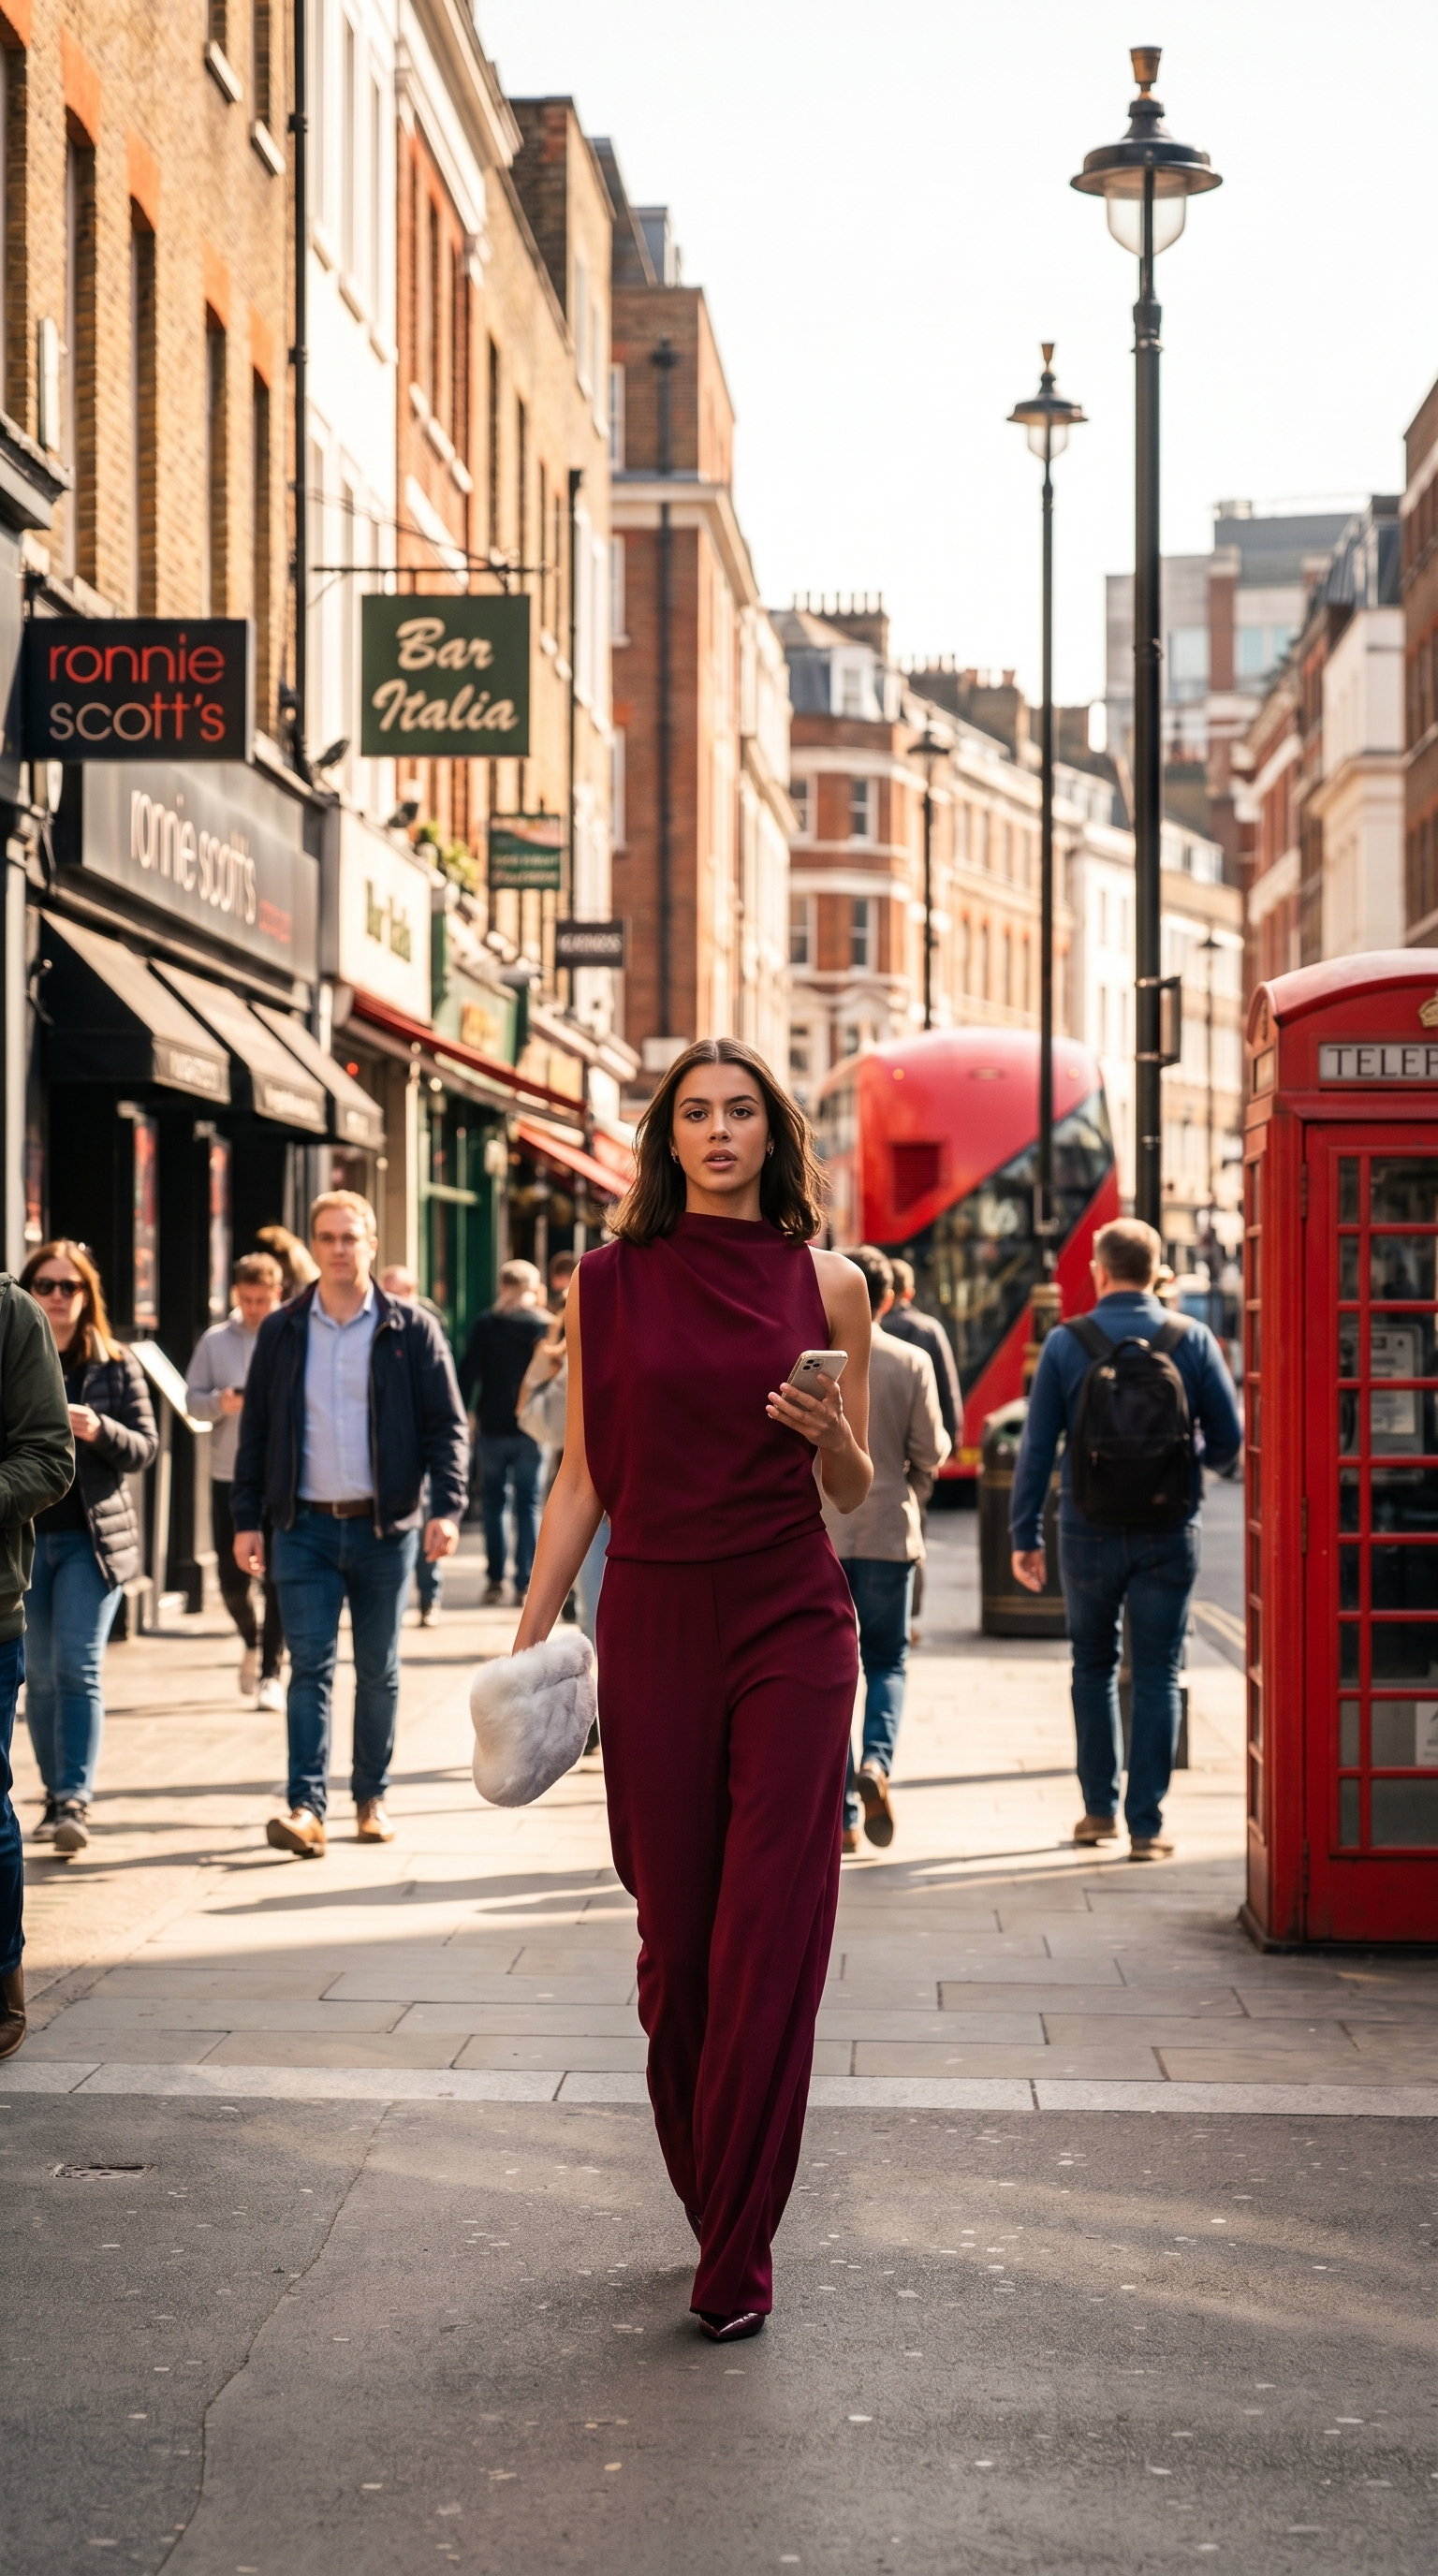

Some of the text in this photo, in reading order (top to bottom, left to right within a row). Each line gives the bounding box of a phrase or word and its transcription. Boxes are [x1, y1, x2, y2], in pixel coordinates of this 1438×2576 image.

[50, 632, 226, 684] ronnie
[396, 617, 494, 671] Bar
[50, 691, 227, 742] scott's
[372, 678, 520, 732] Italia
[130, 789, 198, 892] ronnie
